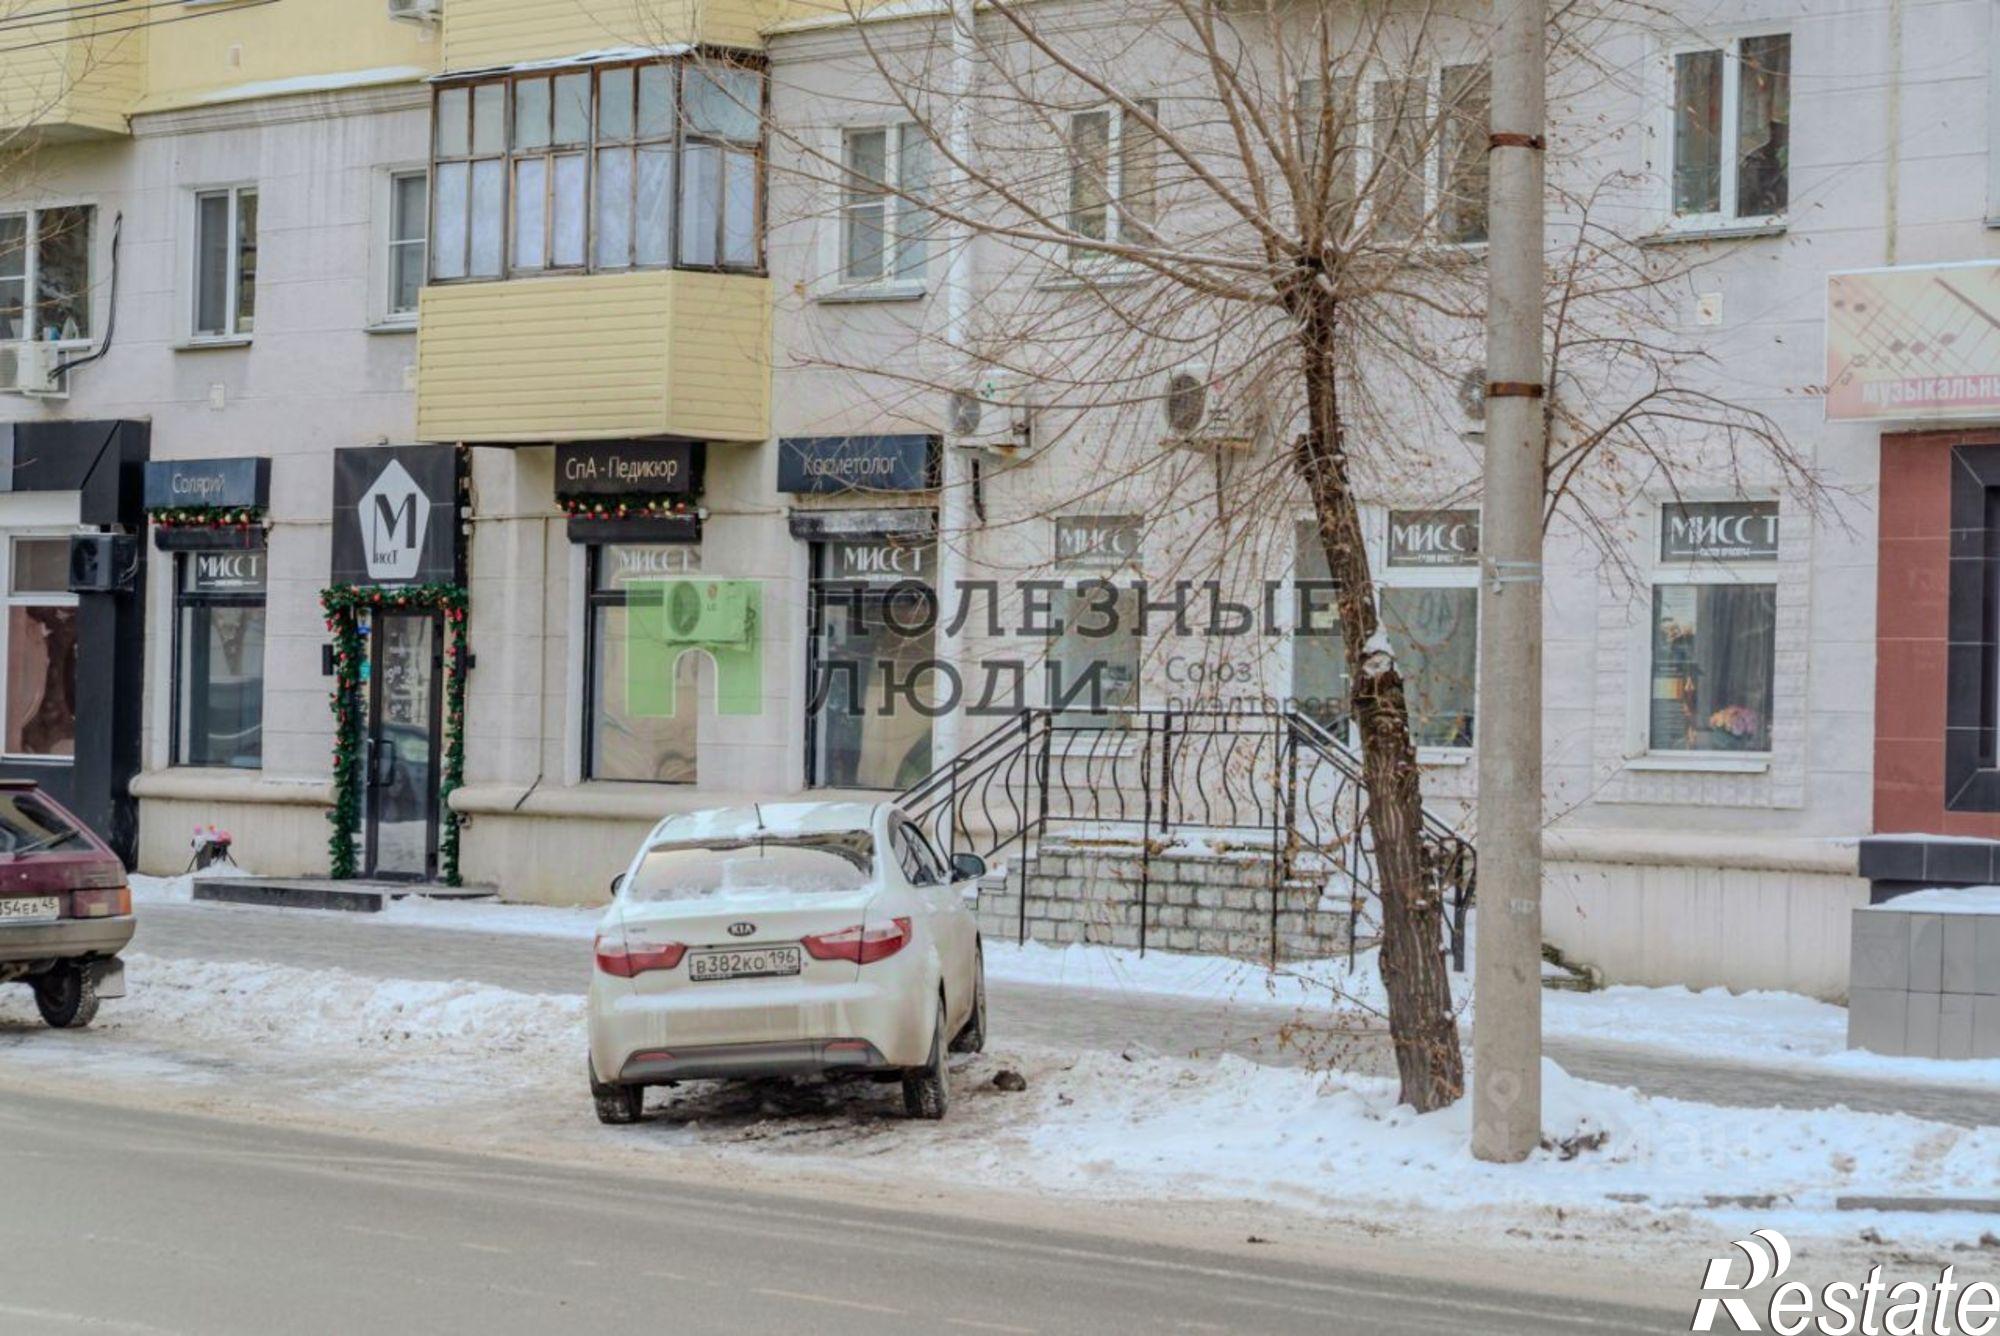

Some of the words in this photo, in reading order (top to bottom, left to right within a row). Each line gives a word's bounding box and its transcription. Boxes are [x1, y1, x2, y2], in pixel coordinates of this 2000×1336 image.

[608, 456, 678, 482] Педикюр
[803, 454, 898, 476] Косметолог
[731, 924, 754, 935] KIA
[769, 951, 795, 965] 196
